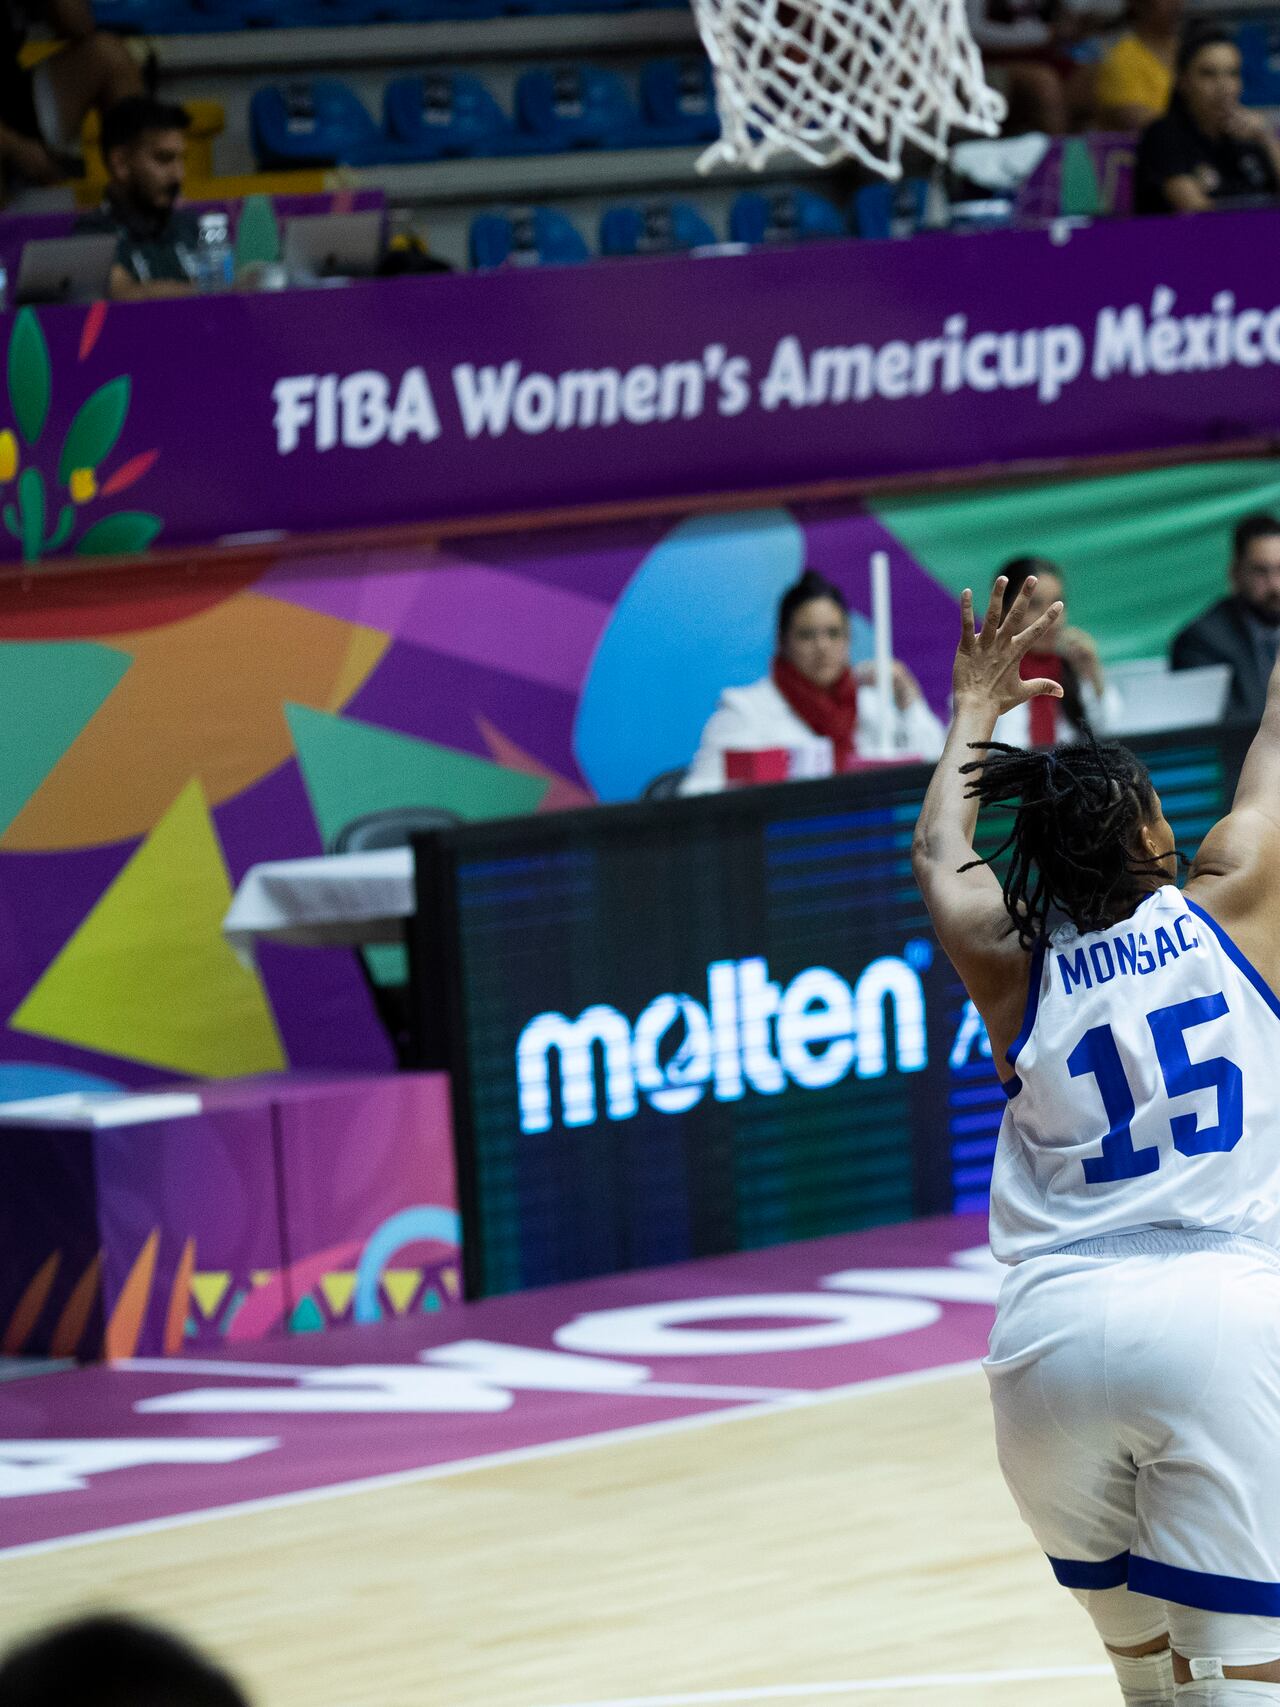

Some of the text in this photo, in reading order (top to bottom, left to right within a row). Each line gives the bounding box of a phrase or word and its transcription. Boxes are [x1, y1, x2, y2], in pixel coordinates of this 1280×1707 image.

[272, 361, 441, 456] FIBA
[451, 342, 751, 441] Women's
[760, 311, 1085, 411] Americup
[1056, 913, 1199, 995] MONSAC
[516, 955, 928, 1134] molten
[1066, 991, 1243, 1184] 15
